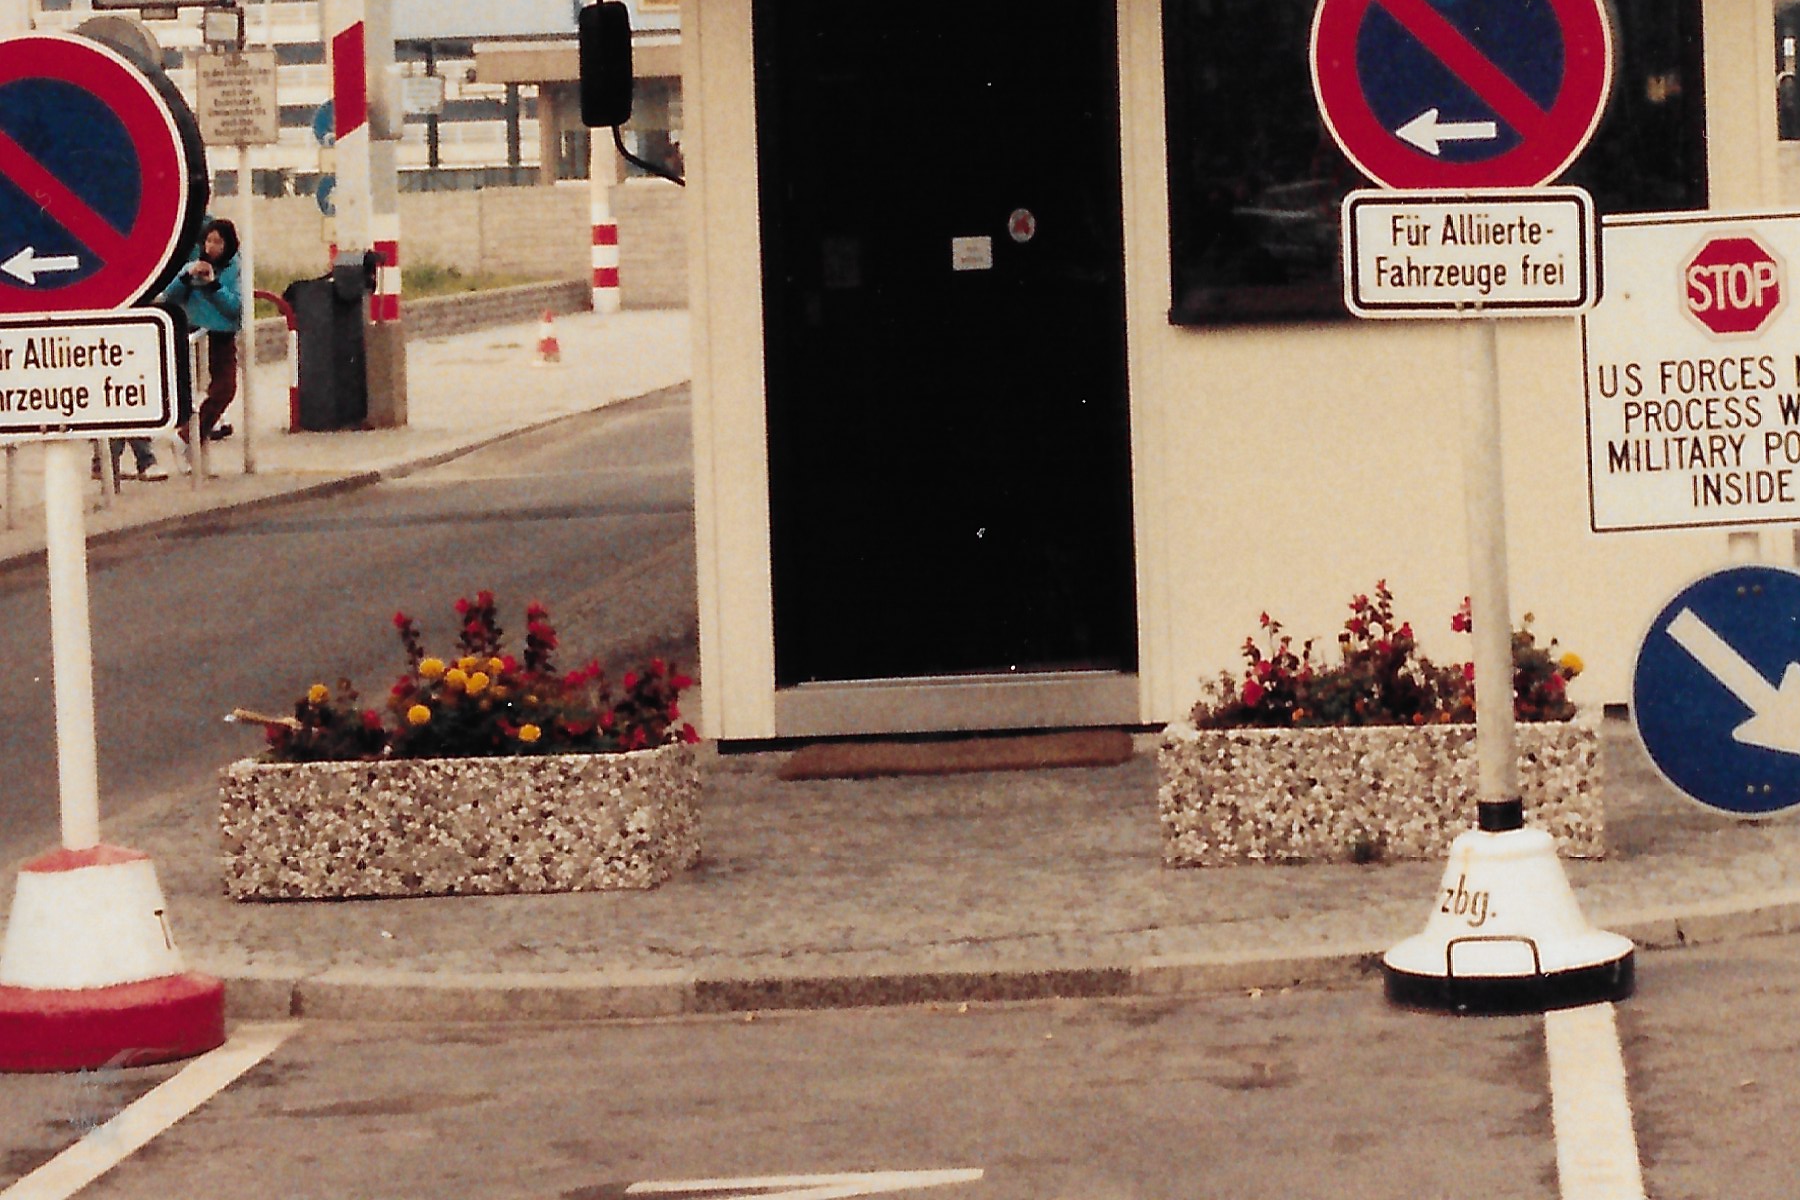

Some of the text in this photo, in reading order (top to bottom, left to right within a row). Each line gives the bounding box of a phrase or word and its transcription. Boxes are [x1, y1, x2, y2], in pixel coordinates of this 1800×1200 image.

[1391, 213, 1555, 246] Für Alliierte-
[1374, 254, 1565, 295] Fahrzeuge frei
[1686, 260, 1780, 312] STOP
[22, 336, 135, 370] Alliierte-
[104, 375, 147, 408] frei
[1599, 363, 1643, 399] US
[1659, 355, 1776, 395] FORCES
[1623, 396, 1762, 434] PROCESS
[1607, 432, 1747, 474] MILITARY
[1692, 468, 1796, 508] INSIDE
